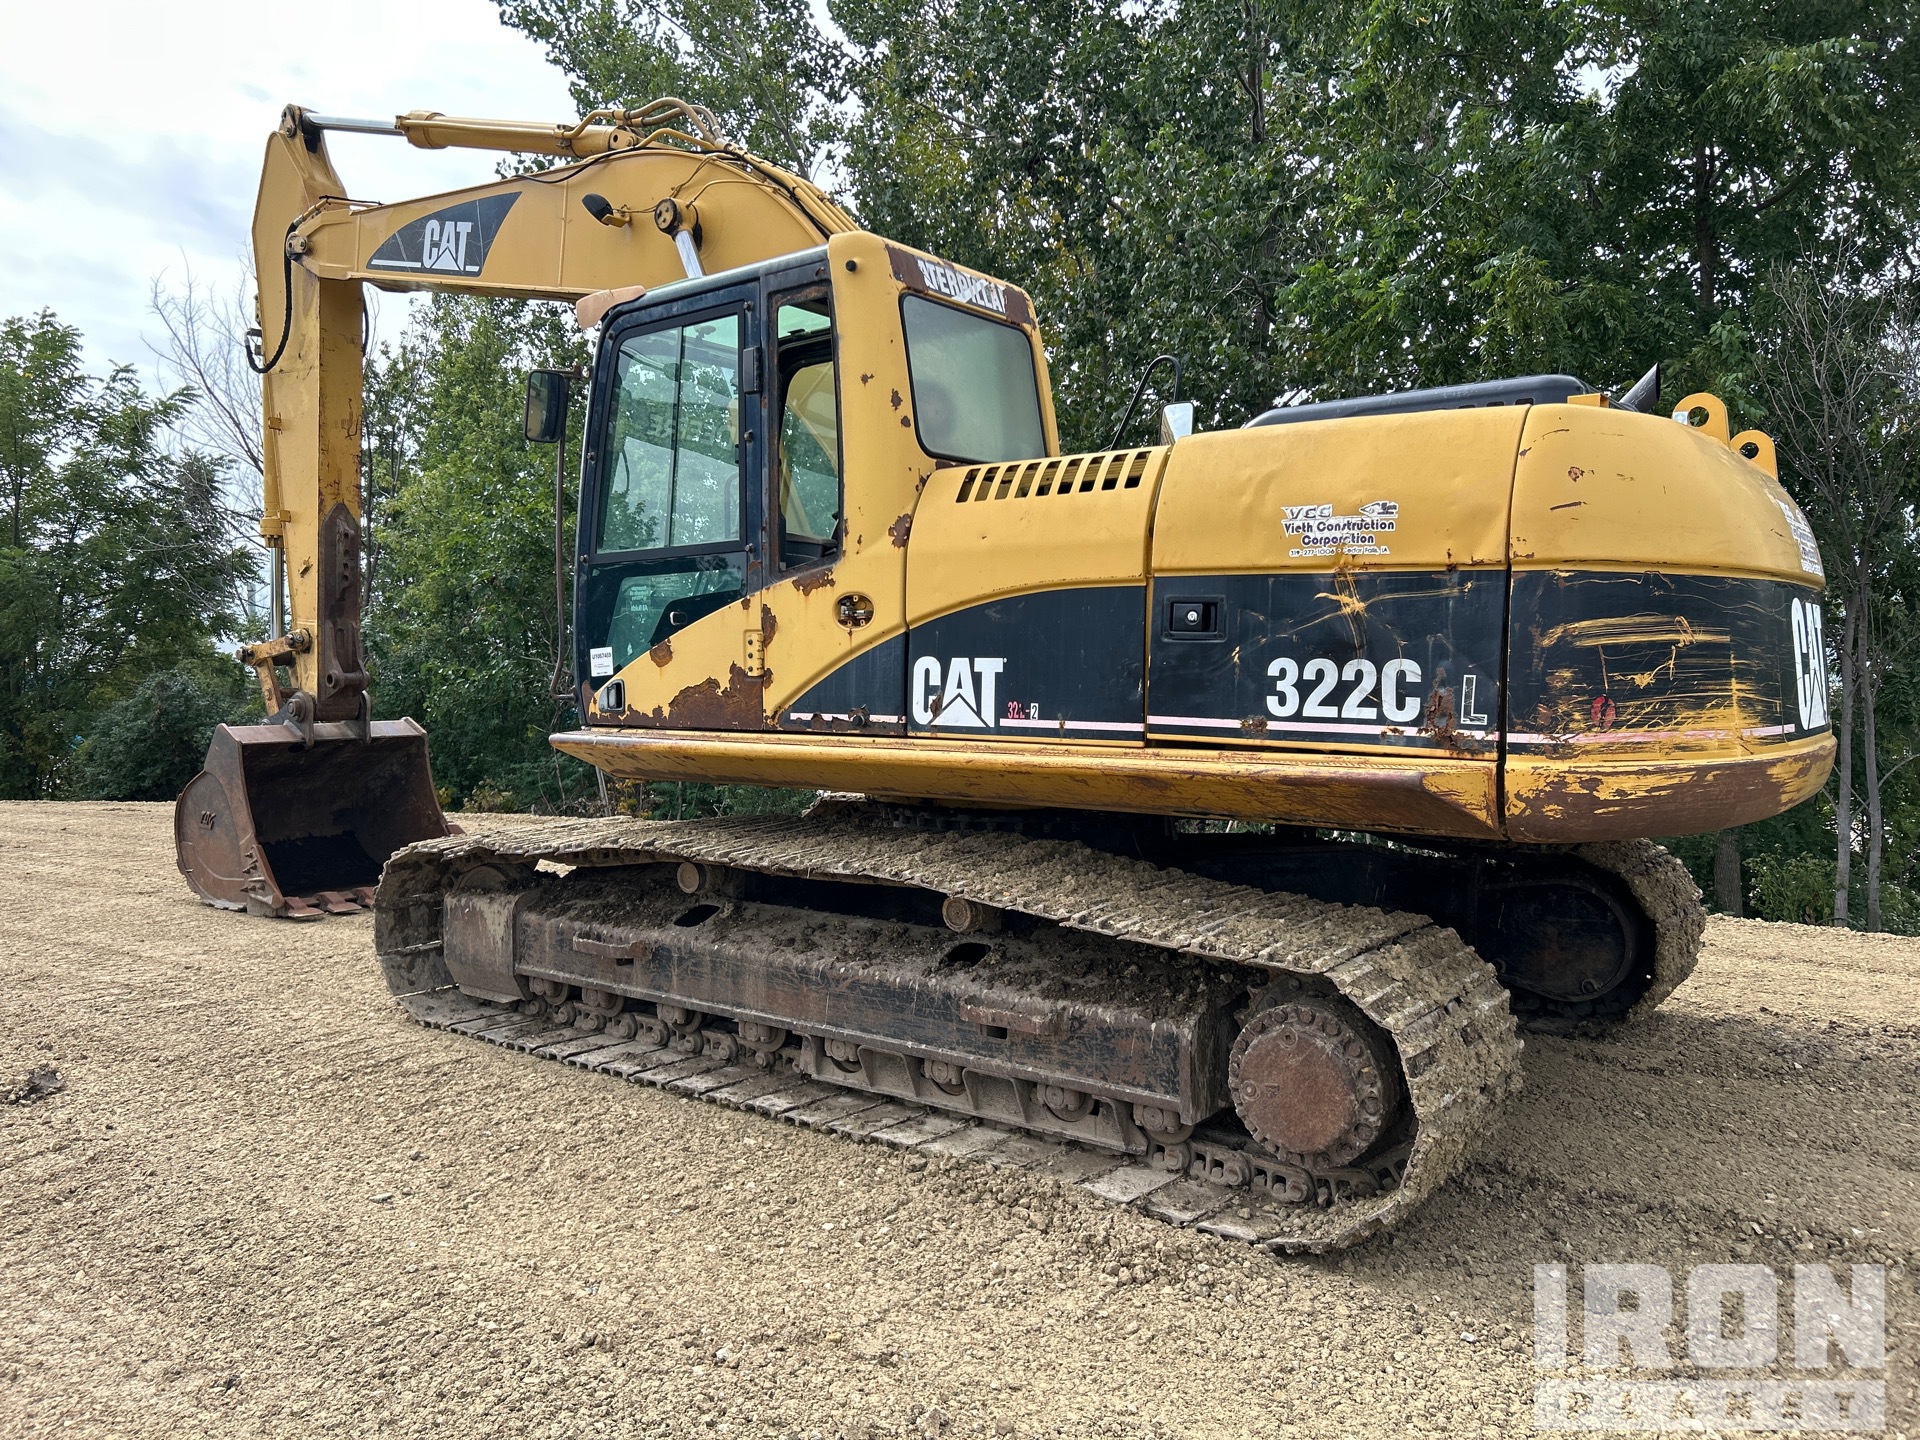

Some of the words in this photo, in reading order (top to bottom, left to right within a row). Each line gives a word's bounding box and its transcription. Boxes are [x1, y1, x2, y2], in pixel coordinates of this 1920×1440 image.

[423, 219, 472, 272] CAT
[1284, 521, 1313, 534] Vieth
[1316, 519, 1395, 533] Construction
[913, 656, 1004, 728] CAT
[1266, 657, 1422, 722] 322C
[1460, 674, 1488, 725] L
[1791, 597, 1830, 730] CAT
